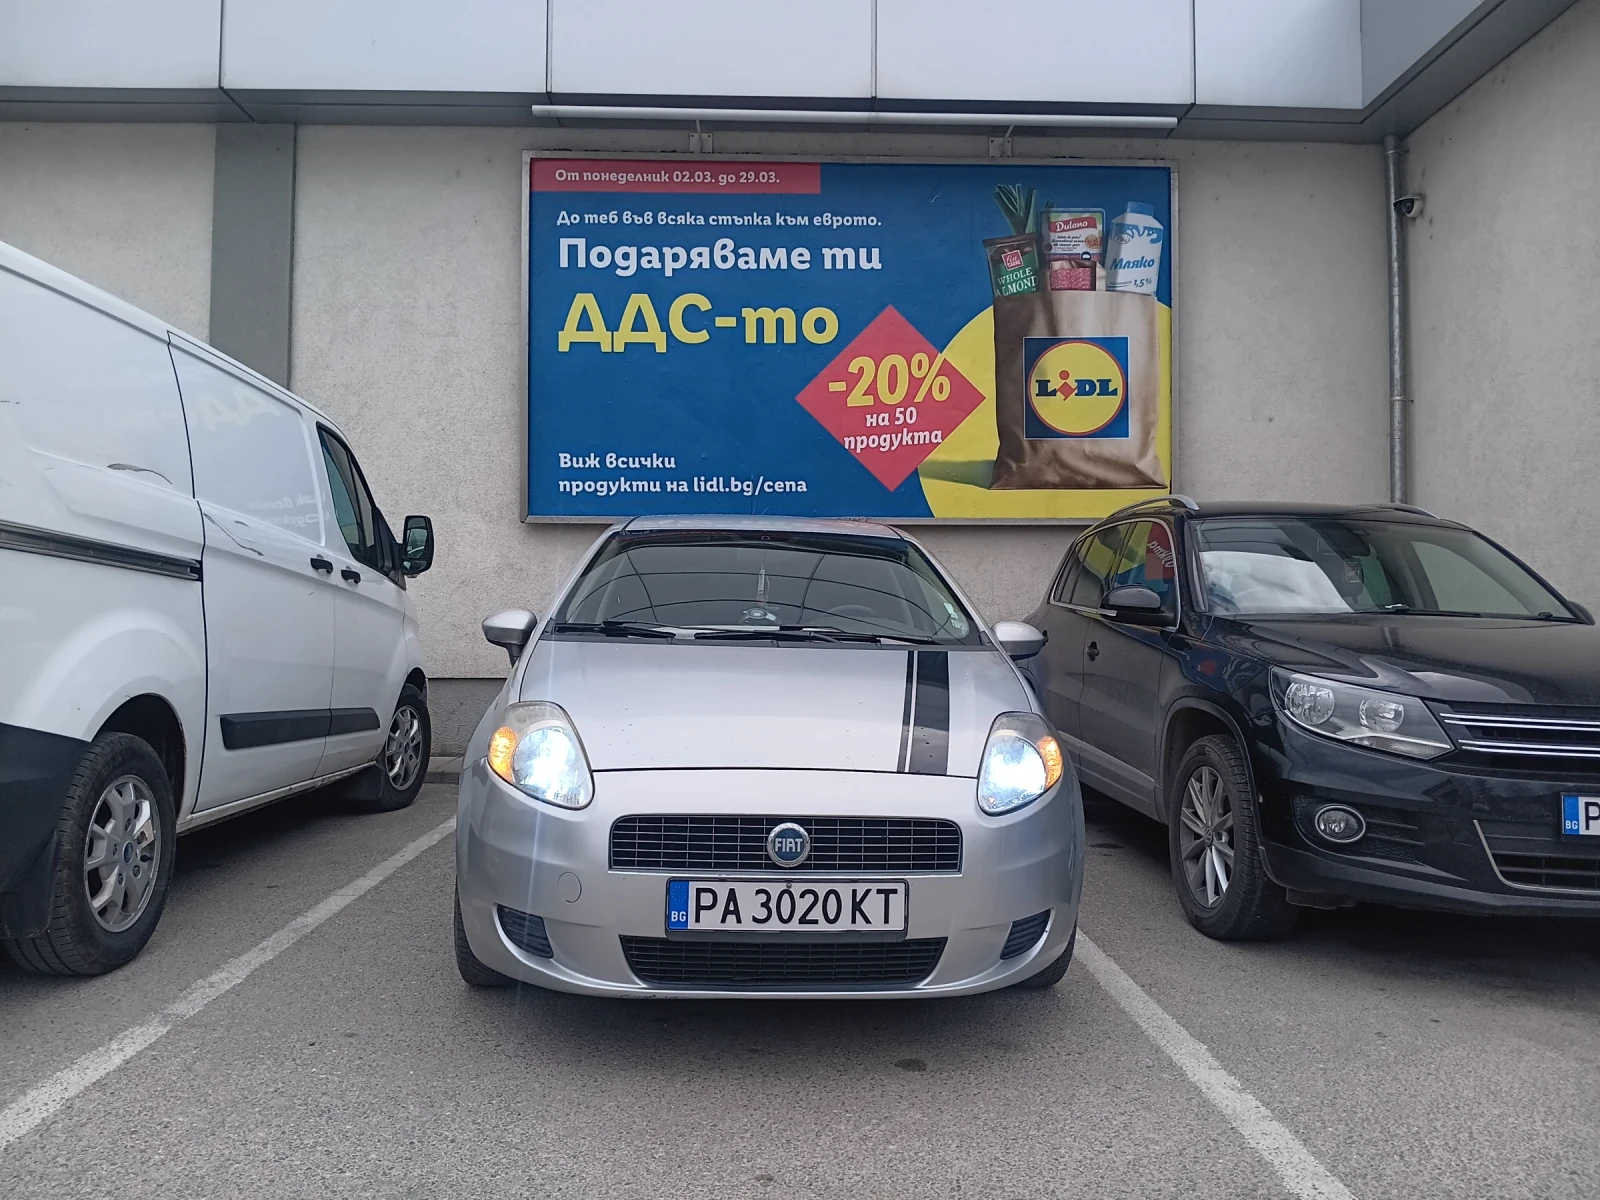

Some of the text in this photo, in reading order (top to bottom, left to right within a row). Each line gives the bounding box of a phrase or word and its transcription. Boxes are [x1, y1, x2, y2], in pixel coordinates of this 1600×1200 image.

[555, 169, 780, 186] От понеделник 02.03. до 29.03.
[556, 210, 882, 229] До теб във всяка стъпка към еврото.
[1055, 221, 1088, 232] Dulano
[559, 238, 882, 277] Подаряваме ти
[1110, 256, 1155, 270] Мляко
[997, 267, 1033, 285] WHOLE
[558, 292, 839, 353] ДДС-то
[828, 352, 951, 407] -20%
[865, 406, 917, 427] на 50
[843, 428, 943, 453] продукта
[558, 452, 676, 469] Виж всички
[558, 476, 807, 496] продукти на lidl.bg/cena
[1565, 820, 1578, 829] BG
[774, 838, 803, 852] FIAT
[694, 887, 898, 925] PA 3020 KT
[671, 911, 687, 922] BG
